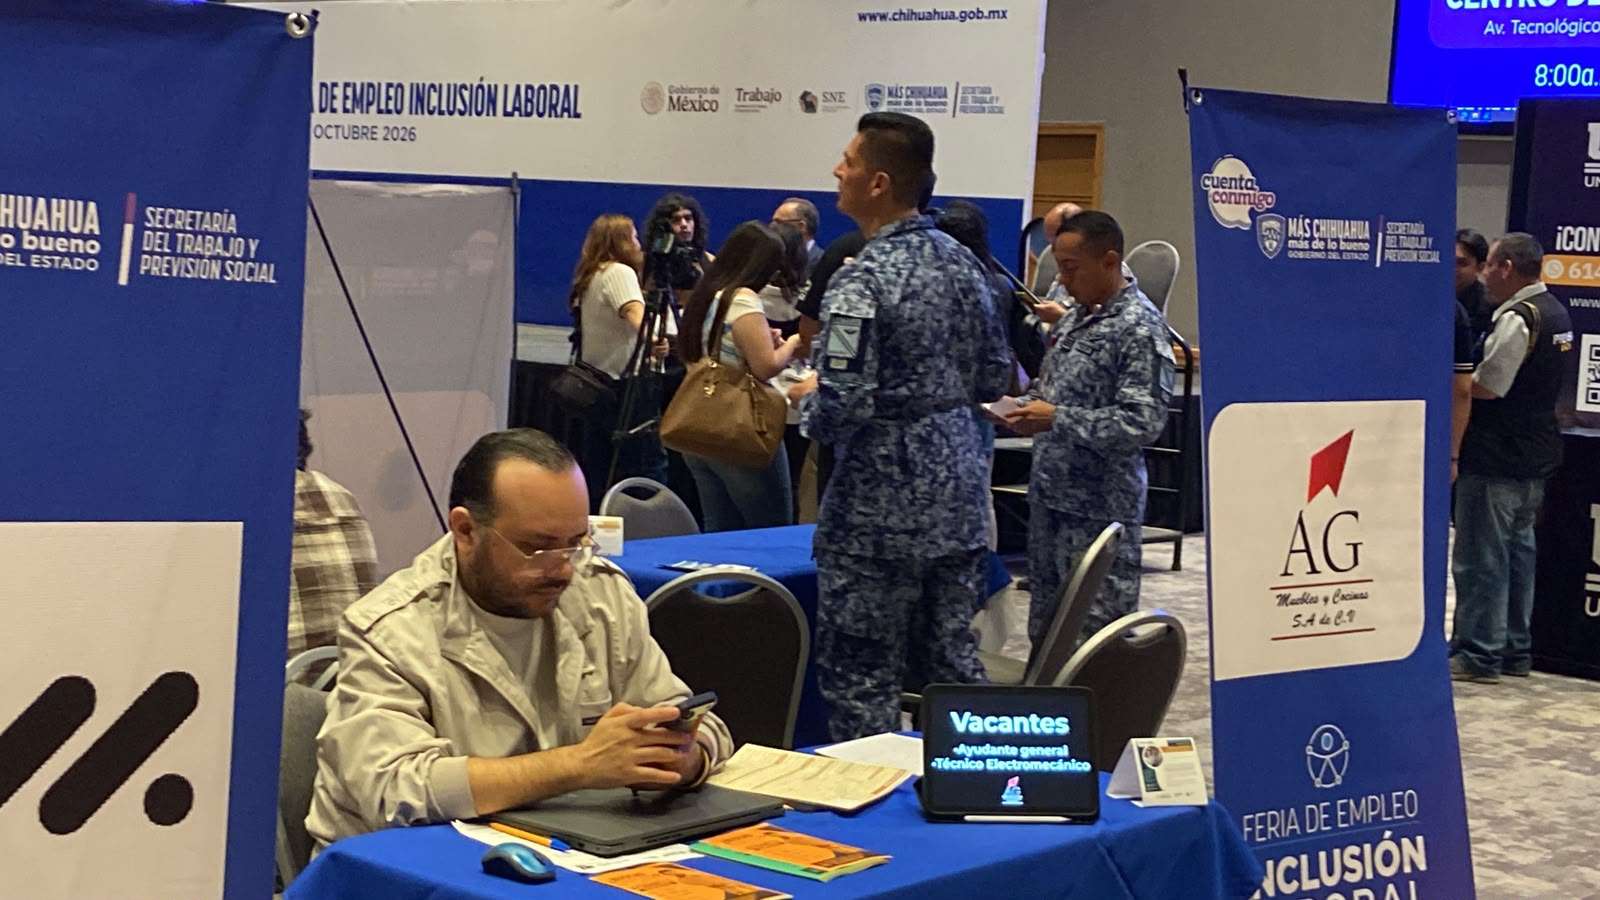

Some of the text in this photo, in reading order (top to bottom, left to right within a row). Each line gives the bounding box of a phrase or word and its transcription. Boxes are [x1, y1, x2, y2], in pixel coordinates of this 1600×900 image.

[858, 8, 1008, 22] www.chihuahua.gob.mx
[1484, 18, 1600, 37] Av. Tecnológico
[1535, 63, 1600, 87] 8:00a.
[319, 76, 581, 118] DE EMPLEO INCLUSIÓN LABORAL
[668, 95, 719, 112] México
[735, 87, 782, 103] Trabajo
[822, 91, 846, 103] SNE
[313, 124, 416, 141] OCTUBRE 2026
[1202, 174, 1257, 191] cuenta
[1213, 191, 1274, 209] conmigo
[0, 193, 100, 235] HUAHUA
[144, 206, 237, 234] SECRETARÍA
[1287, 215, 1370, 240] MÁS CHIHUAHUA
[22, 230, 101, 254] bueno
[142, 231, 260, 259] DEL TRABAJO Y
[1287, 239, 1309, 249] más
[1311, 239, 1325, 249] de
[1340, 239, 1370, 251] bueno
[31, 254, 98, 271] ESTADO
[140, 255, 277, 284] PREVISIÓN SOCIAL
[1280, 509, 1363, 576] AG
[1276, 591, 1319, 607] Muebles
[1333, 588, 1369, 604] Cocinas
[1319, 614, 1331, 625] de
[950, 711, 1070, 735] Vacantes
[1019, 744, 1070, 758] general
[986, 758, 1091, 772] Electromecánico
[1243, 789, 1419, 842] FERIA DE EMPLEO
[1250, 830, 1428, 899] NCLUSIÓN
